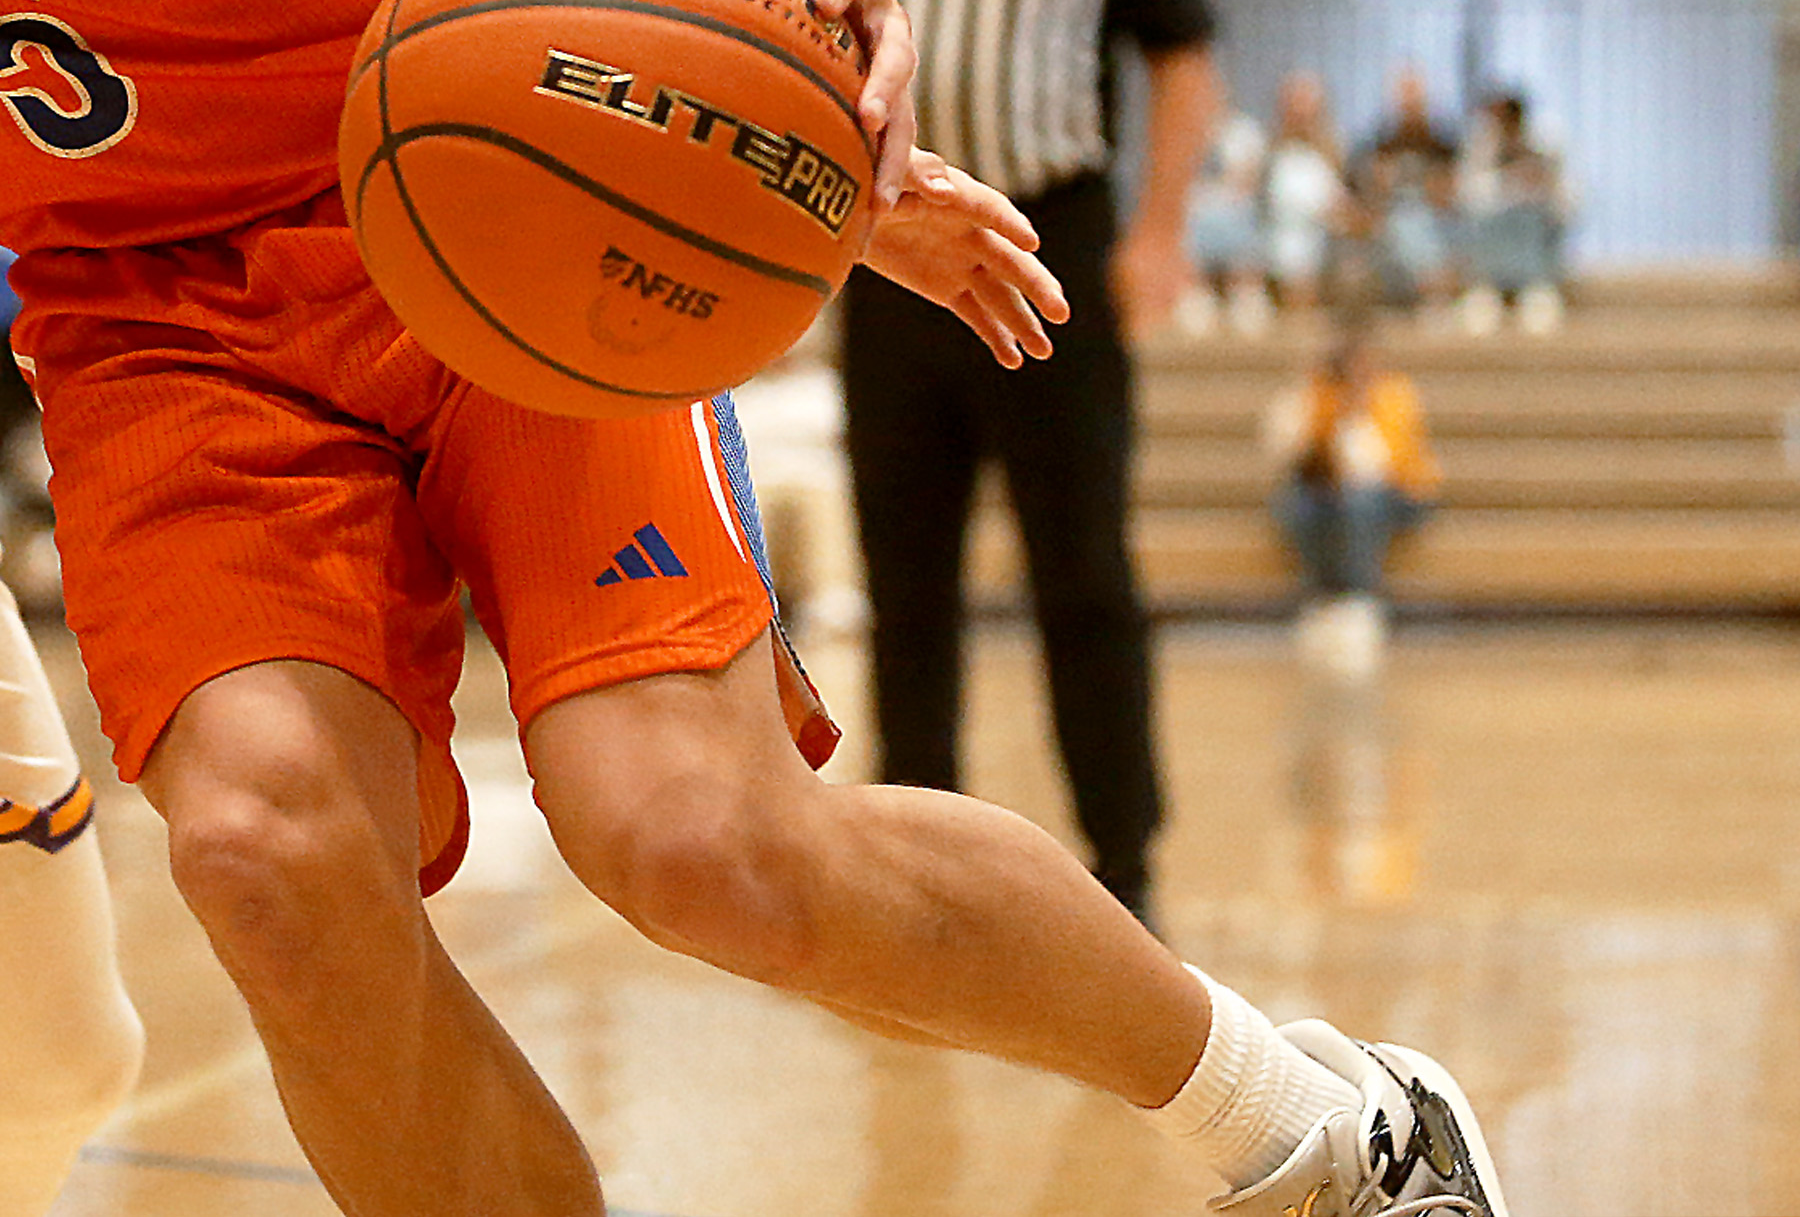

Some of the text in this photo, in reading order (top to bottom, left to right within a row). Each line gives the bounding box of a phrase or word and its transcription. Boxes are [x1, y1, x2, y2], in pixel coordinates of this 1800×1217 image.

[533, 47, 861, 228] ELITE PRO
[621, 263, 721, 320] NFHS
